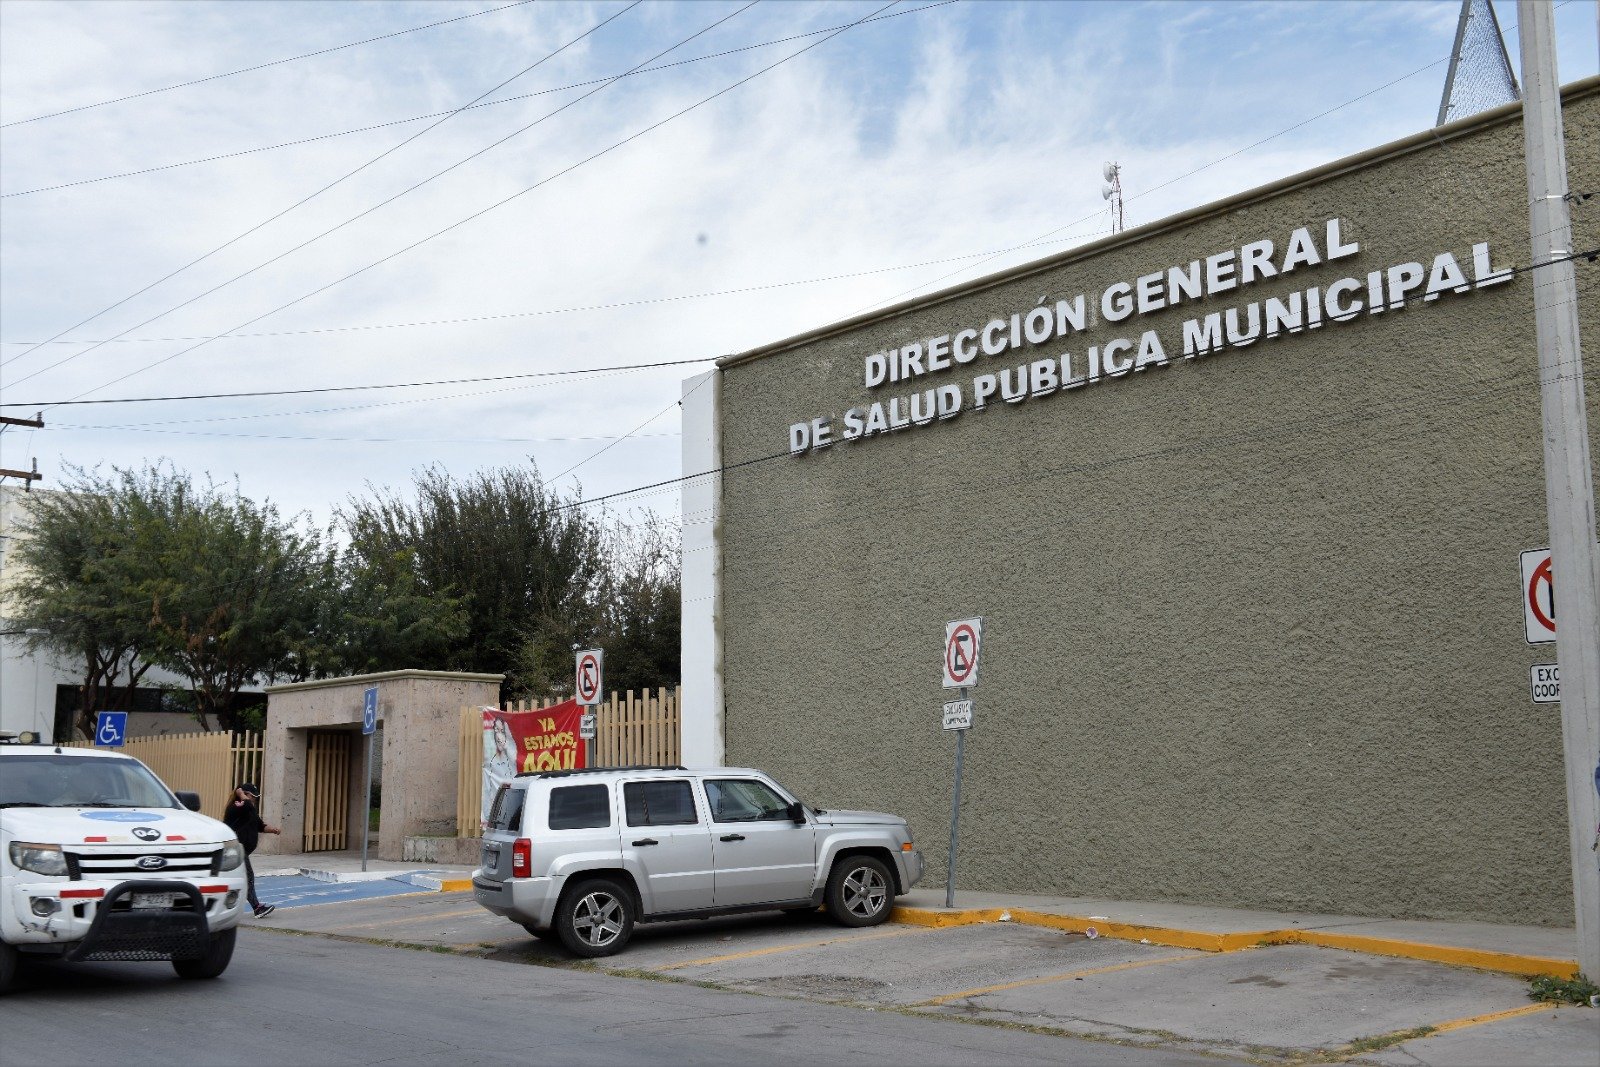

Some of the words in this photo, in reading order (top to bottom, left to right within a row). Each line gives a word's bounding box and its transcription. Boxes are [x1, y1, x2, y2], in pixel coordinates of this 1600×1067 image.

[864, 294, 1086, 389] DIRECCIÓN
[1100, 218, 1359, 323] GENERAL
[789, 417, 833, 455] DE
[843, 383, 962, 441] SALUD
[973, 330, 1169, 411] PUBLICA
[1182, 242, 1513, 360] MUNICIPAL
[537, 717, 556, 732] YA
[523, 731, 574, 751] ESTAMOS
[133, 829, 160, 838] 04
